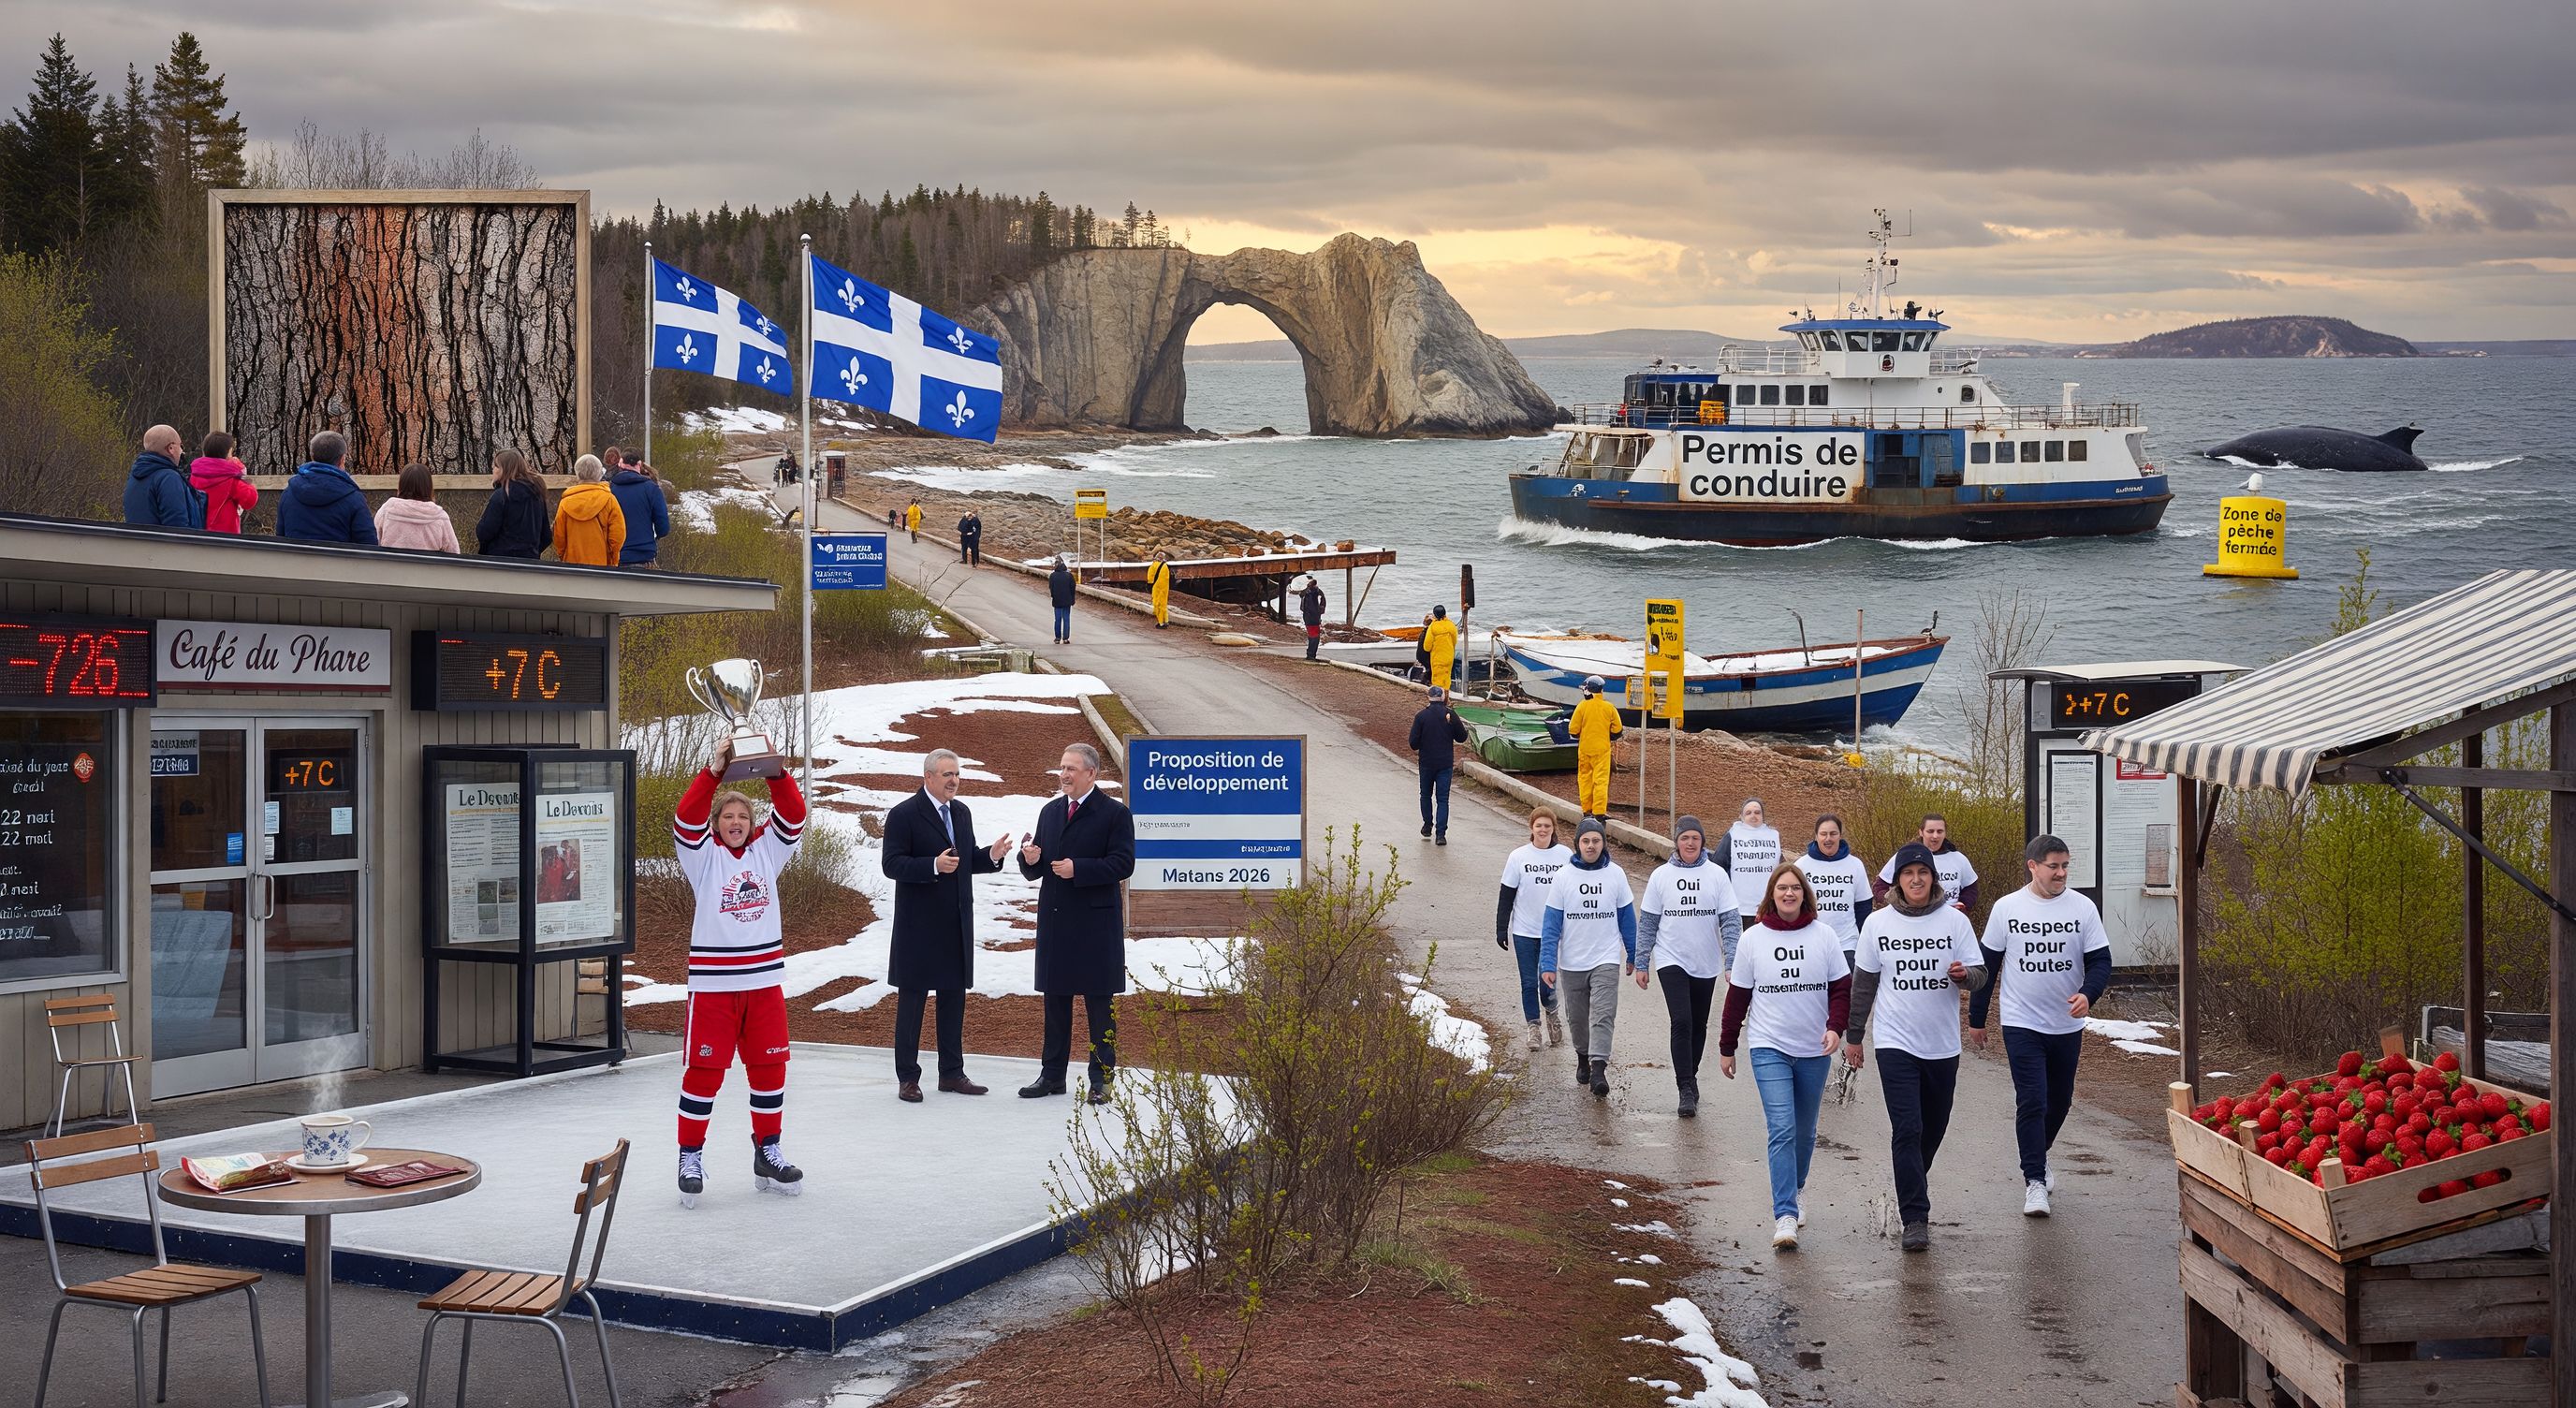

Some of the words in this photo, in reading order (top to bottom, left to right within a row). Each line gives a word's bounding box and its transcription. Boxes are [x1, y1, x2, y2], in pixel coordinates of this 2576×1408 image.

[1682, 435, 1803, 465] Permis
[1816, 437, 1858, 466] de
[1690, 469, 1847, 498] conduire
[2223, 506, 2260, 521] Zone
[169, 628, 239, 682] Café
[245, 633, 280, 671] du
[290, 634, 371, 674] Phare
[1149, 751, 1255, 770] Proposition
[1261, 751, 1284, 768] de
[1143, 774, 1289, 795] développement
[459, 790, 476, 807] Le
[546, 800, 561, 818] Le
[1229, 869, 1270, 883] 2026
[1579, 883, 1603, 895] Oui
[1676, 878, 1700, 891] Oui
[1680, 896, 1697, 905] au
[1816, 889, 1845, 901] pour
[1582, 900, 1598, 909] au
[1816, 902, 1850, 912] outes
[2008, 919, 2081, 937] Respect
[1878, 935, 1954, 953] Respect
[2025, 942, 2067, 957] pour
[1774, 945, 1805, 961] Oui
[1780, 967, 1800, 979] au
[1895, 959, 1939, 975] pour
[2019, 958, 2073, 973] toutes
[1892, 975, 1950, 991] toutes
